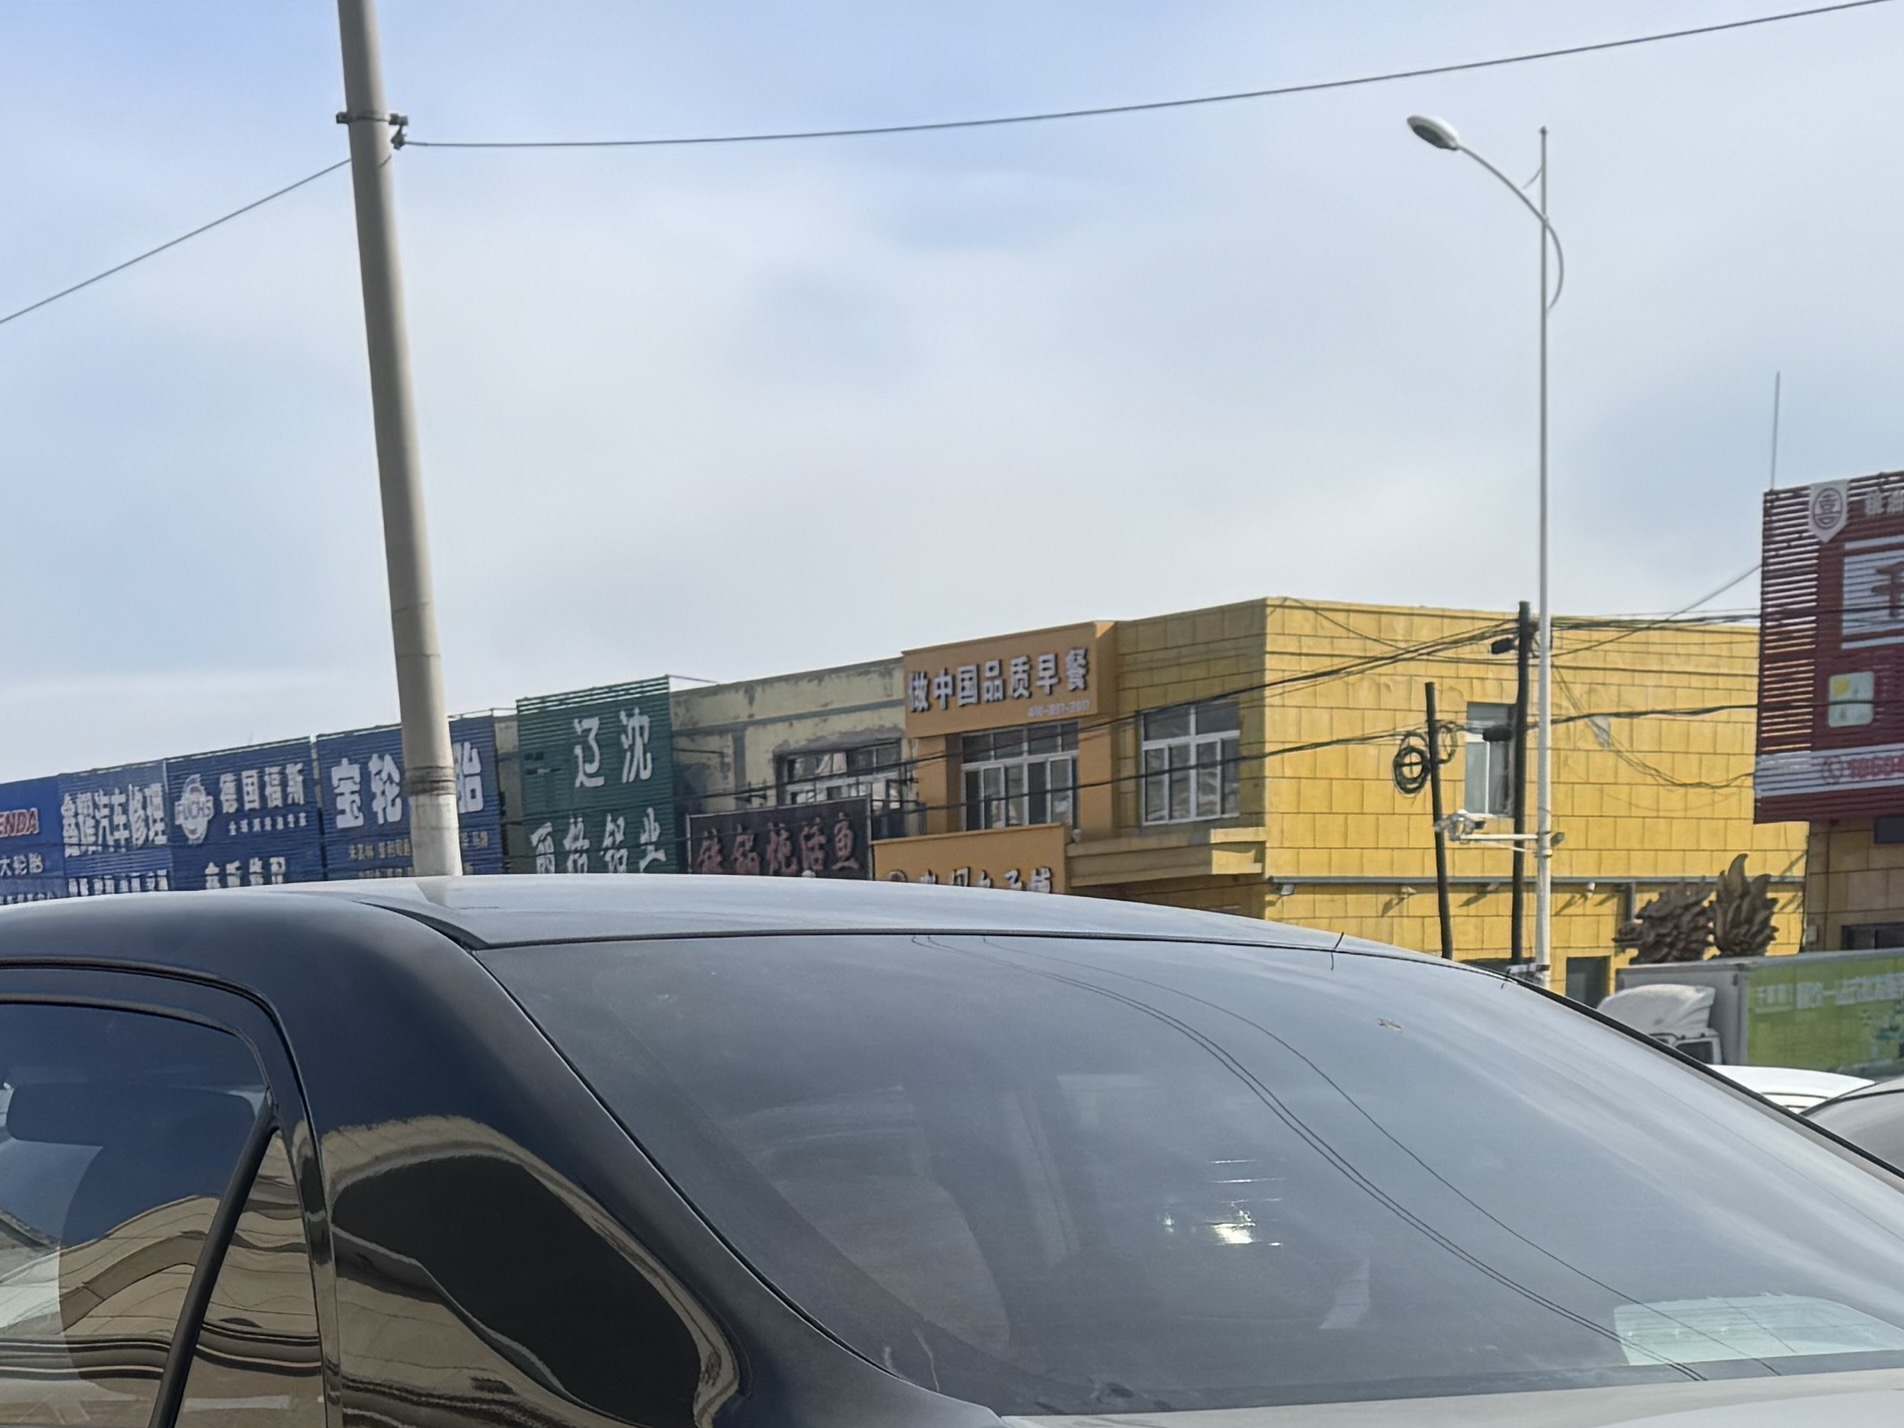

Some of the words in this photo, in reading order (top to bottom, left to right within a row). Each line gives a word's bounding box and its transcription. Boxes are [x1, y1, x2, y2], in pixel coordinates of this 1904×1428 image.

[909, 647, 1089, 713] 做中国品质早餐
[331, 742, 484, 829] 宝轮胎
